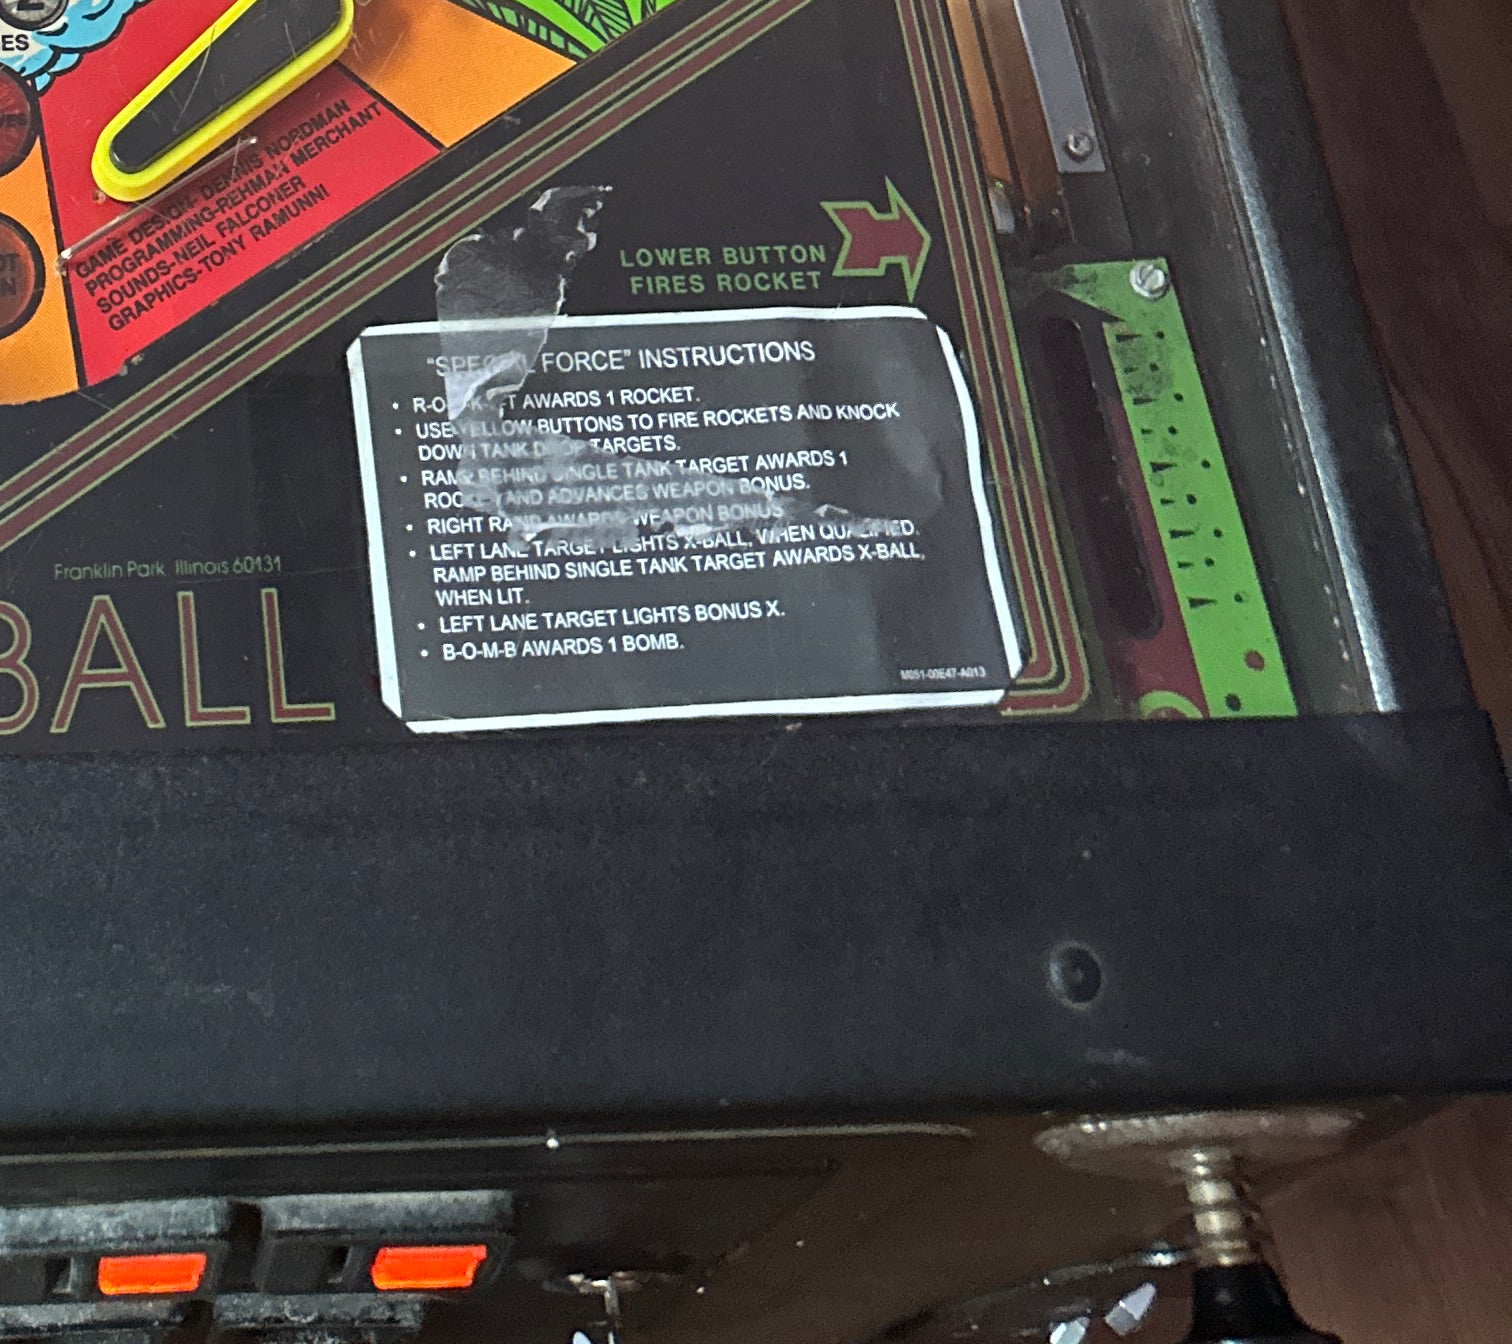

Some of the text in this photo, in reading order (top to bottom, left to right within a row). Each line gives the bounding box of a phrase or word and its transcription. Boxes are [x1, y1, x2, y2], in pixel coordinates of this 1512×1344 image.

[291, 102, 383, 169] MERCHANT
[74, 99, 351, 279] GAME DENNIS NORDMAN
[217, 175, 308, 236] FALCONER
[250, 183, 331, 242] RAMUNNI
[619, 244, 827, 271] LOWER BUTTON
[630, 270, 822, 293] FIRES ROCKET
[638, 341, 816, 369] INSTRUCTIONS
[523, 389, 601, 409] AWARDS
[619, 385, 700, 405] ROCKET.
[538, 402, 900, 434] BUTTONS ROCKETS AND KNOCK
[755, 450, 833, 469] AWARDS
[427, 516, 484, 535] RIGHT
[54, 560, 124, 582] Franklin
[126, 559, 166, 578] Park
[233, 555, 282, 574] 60131
[433, 547, 855, 583] RAMP BEHIND SINGLE TANK TARGET AWARDS
[435, 588, 493, 607] WHEN
[439, 602, 762, 634] LEFT LANE TARGET LIGHTS BONUS
[521, 638, 603, 657] AWARDS
